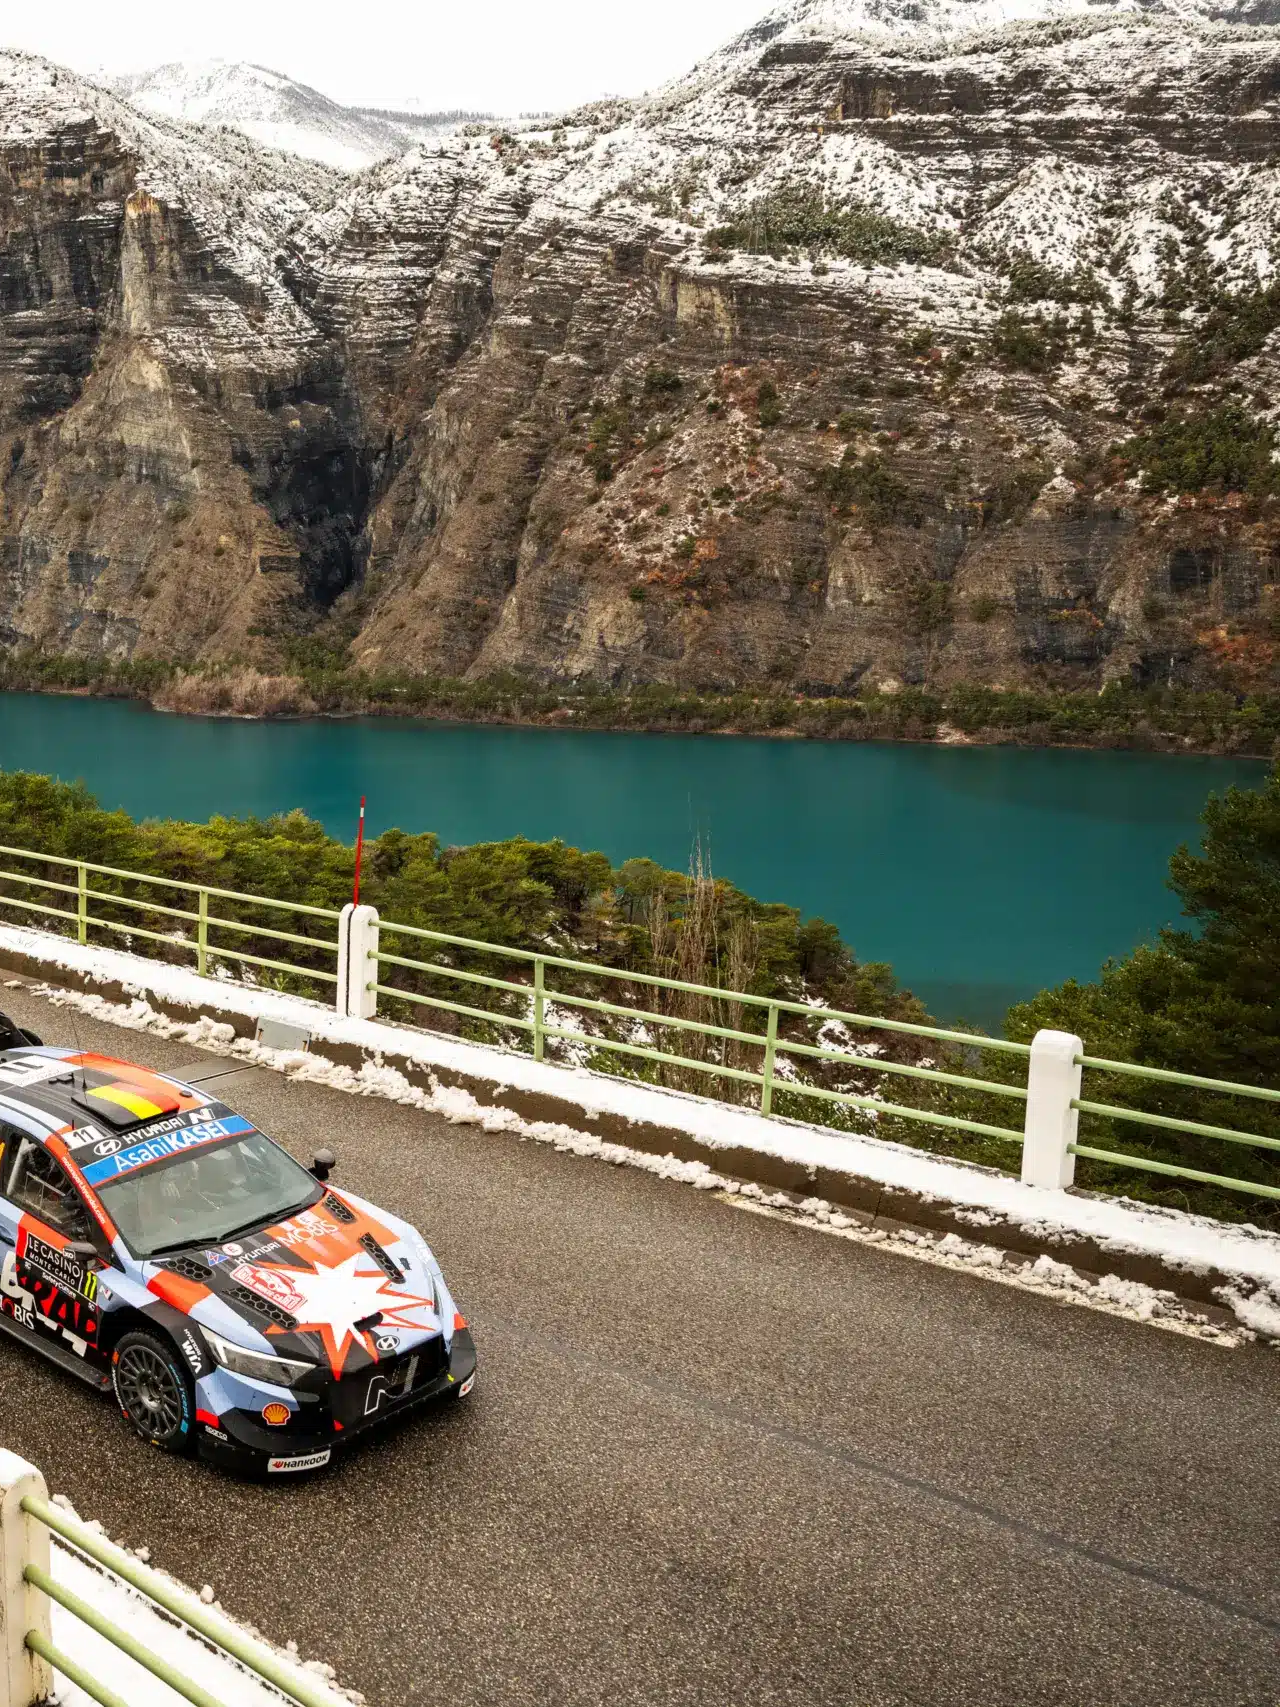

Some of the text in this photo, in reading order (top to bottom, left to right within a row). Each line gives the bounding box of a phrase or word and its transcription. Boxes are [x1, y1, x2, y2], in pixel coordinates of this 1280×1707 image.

[72, 1129, 91, 1144] 11
[114, 1121, 231, 1172] AsahiKASEI
[122, 1116, 186, 1144] HYUNDAI
[61, 1156, 106, 1225] motorsport.hyundai.com
[29, 1237, 80, 1278] LE CASINO
[234, 1219, 339, 1264] HYUNDAI MOBIS
[29, 1252, 76, 1285] MONTE-CARLO
[84, 1271, 97, 1300] 11
[183, 1328, 202, 1356] HYUNDAI
